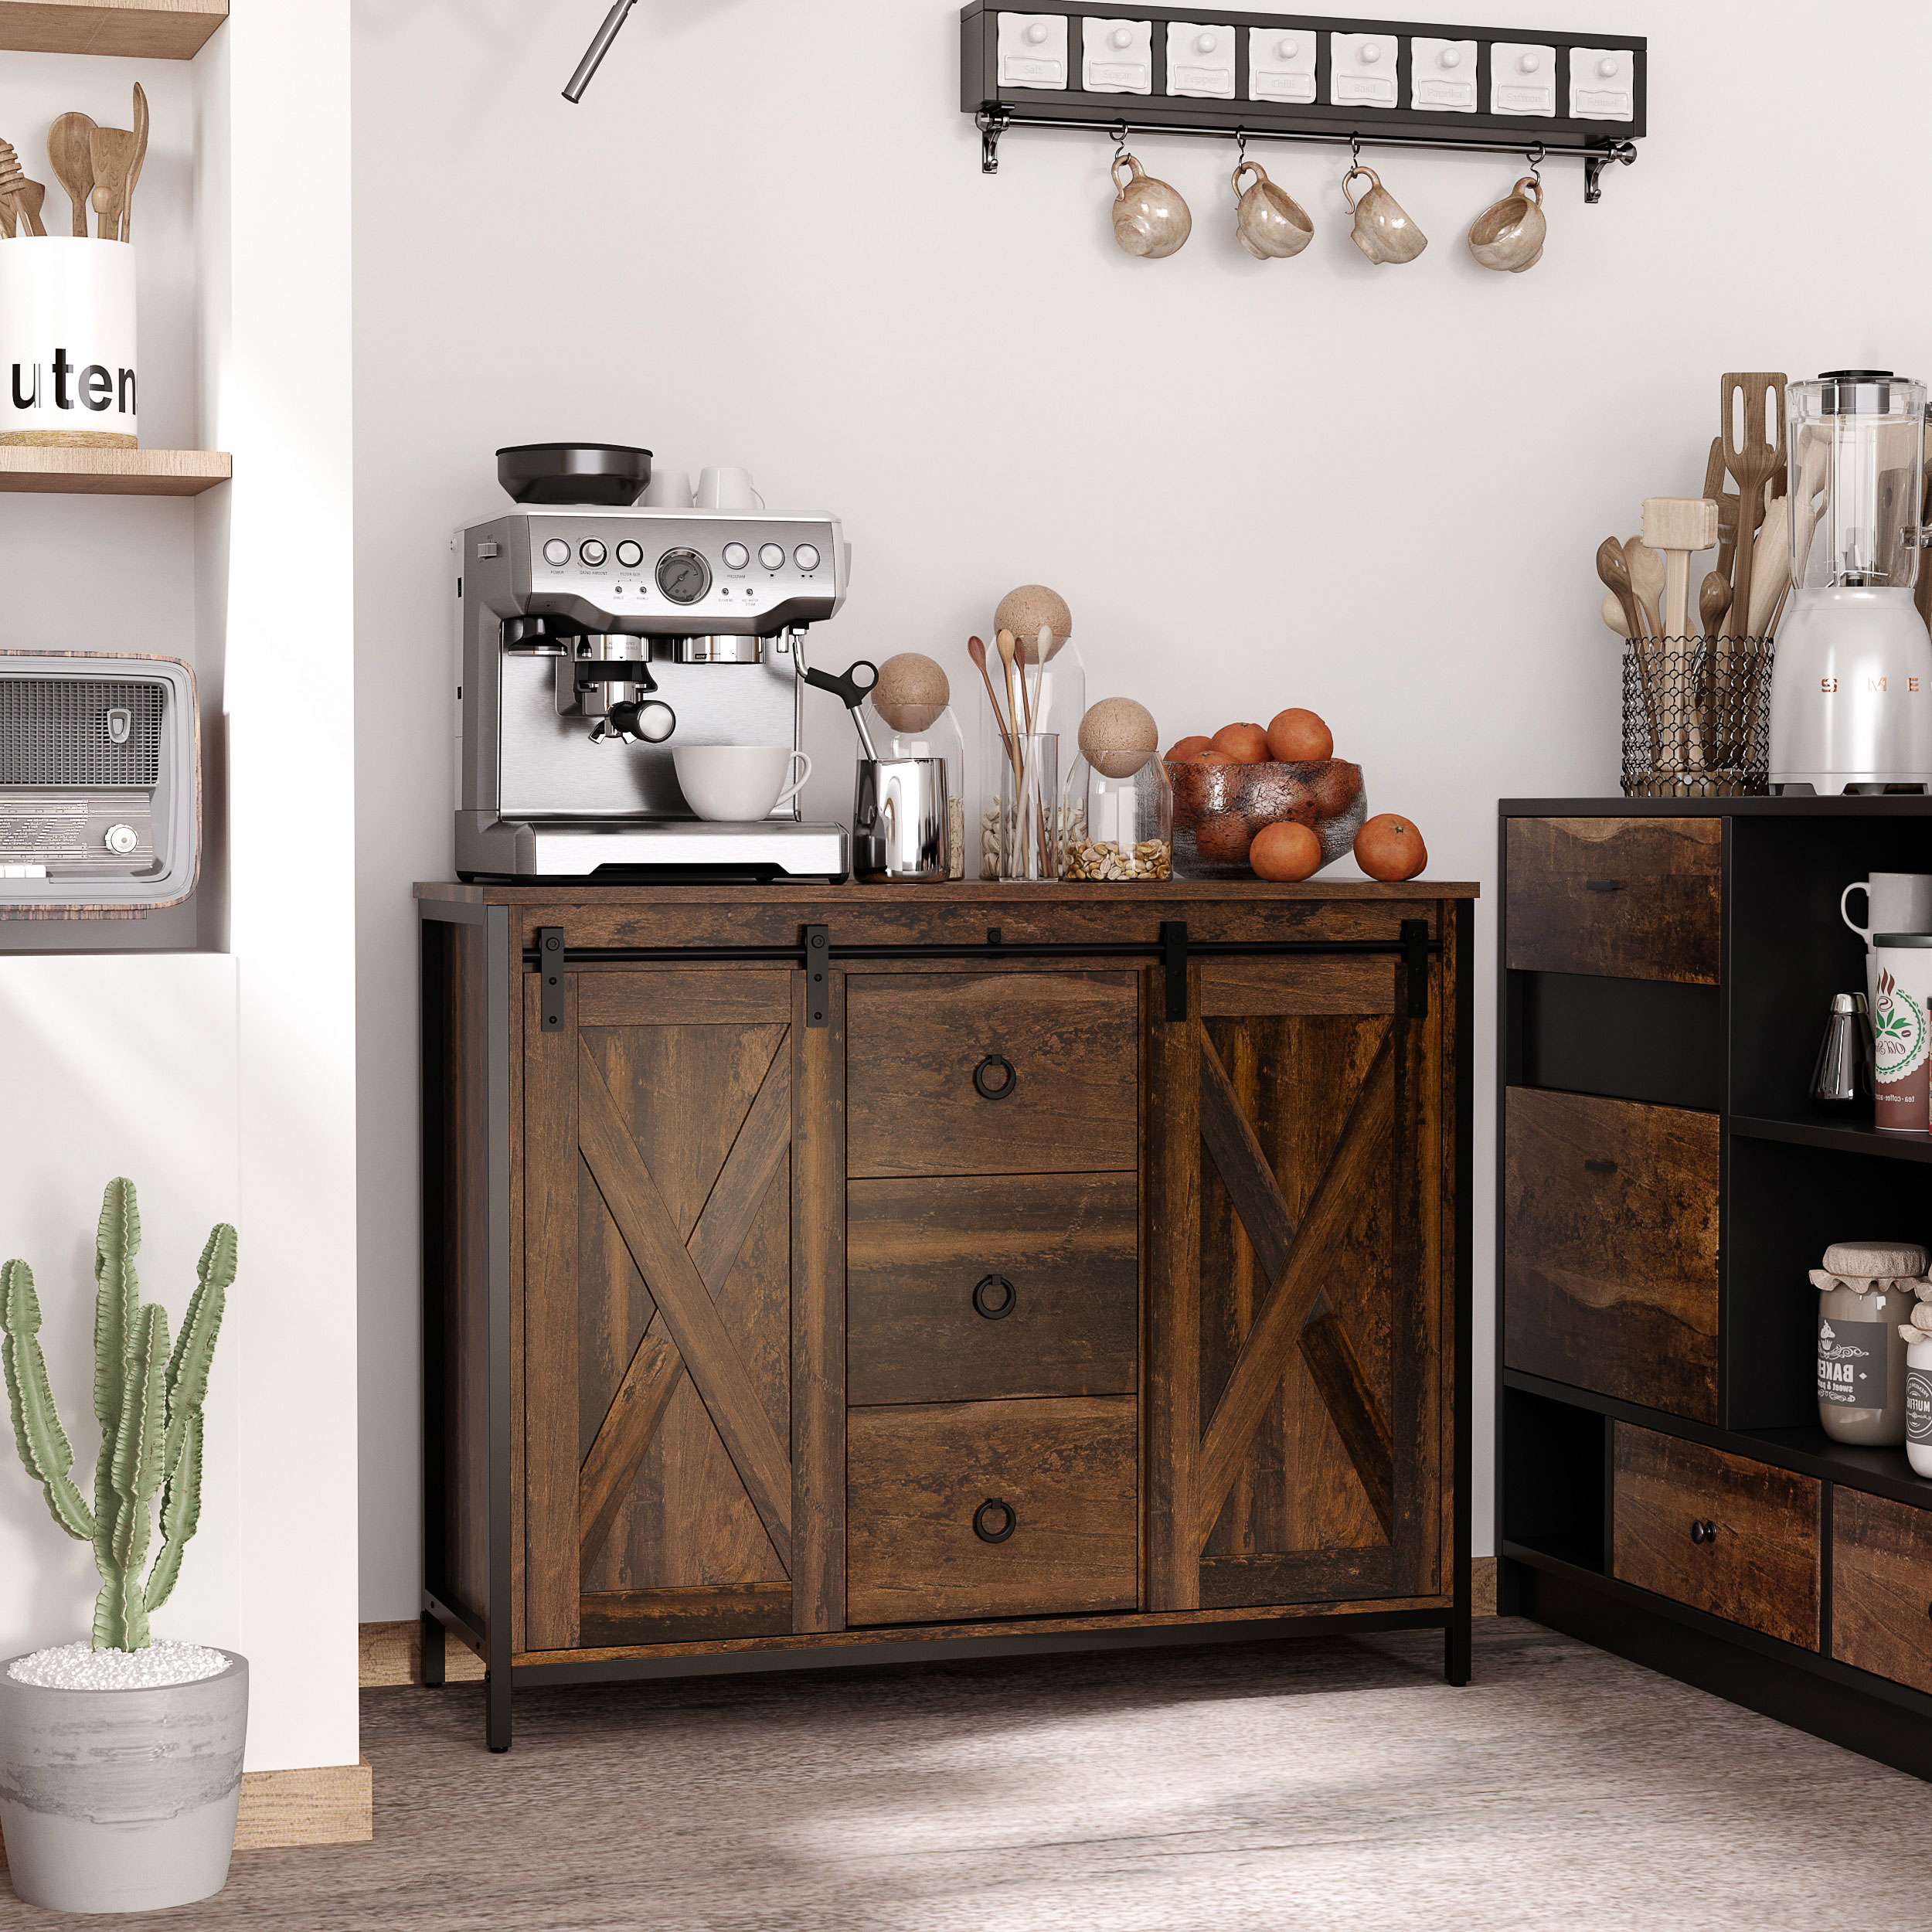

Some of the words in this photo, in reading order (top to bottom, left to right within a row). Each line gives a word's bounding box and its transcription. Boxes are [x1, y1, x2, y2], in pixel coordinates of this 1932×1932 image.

[1023, 65, 1043, 75] Salt
[1103, 70, 1131, 81] Sugar
[1184, 74, 1219, 86] Pepper
[1271, 79, 1296, 89] Chilli
[1354, 84, 1376, 94] Basil
[1427, 87, 1463, 99] Paprika
[1506, 93, 1542, 103] Saffron
[12, 349, 137, 416] uten
[1821, 677, 1932, 692] SME
